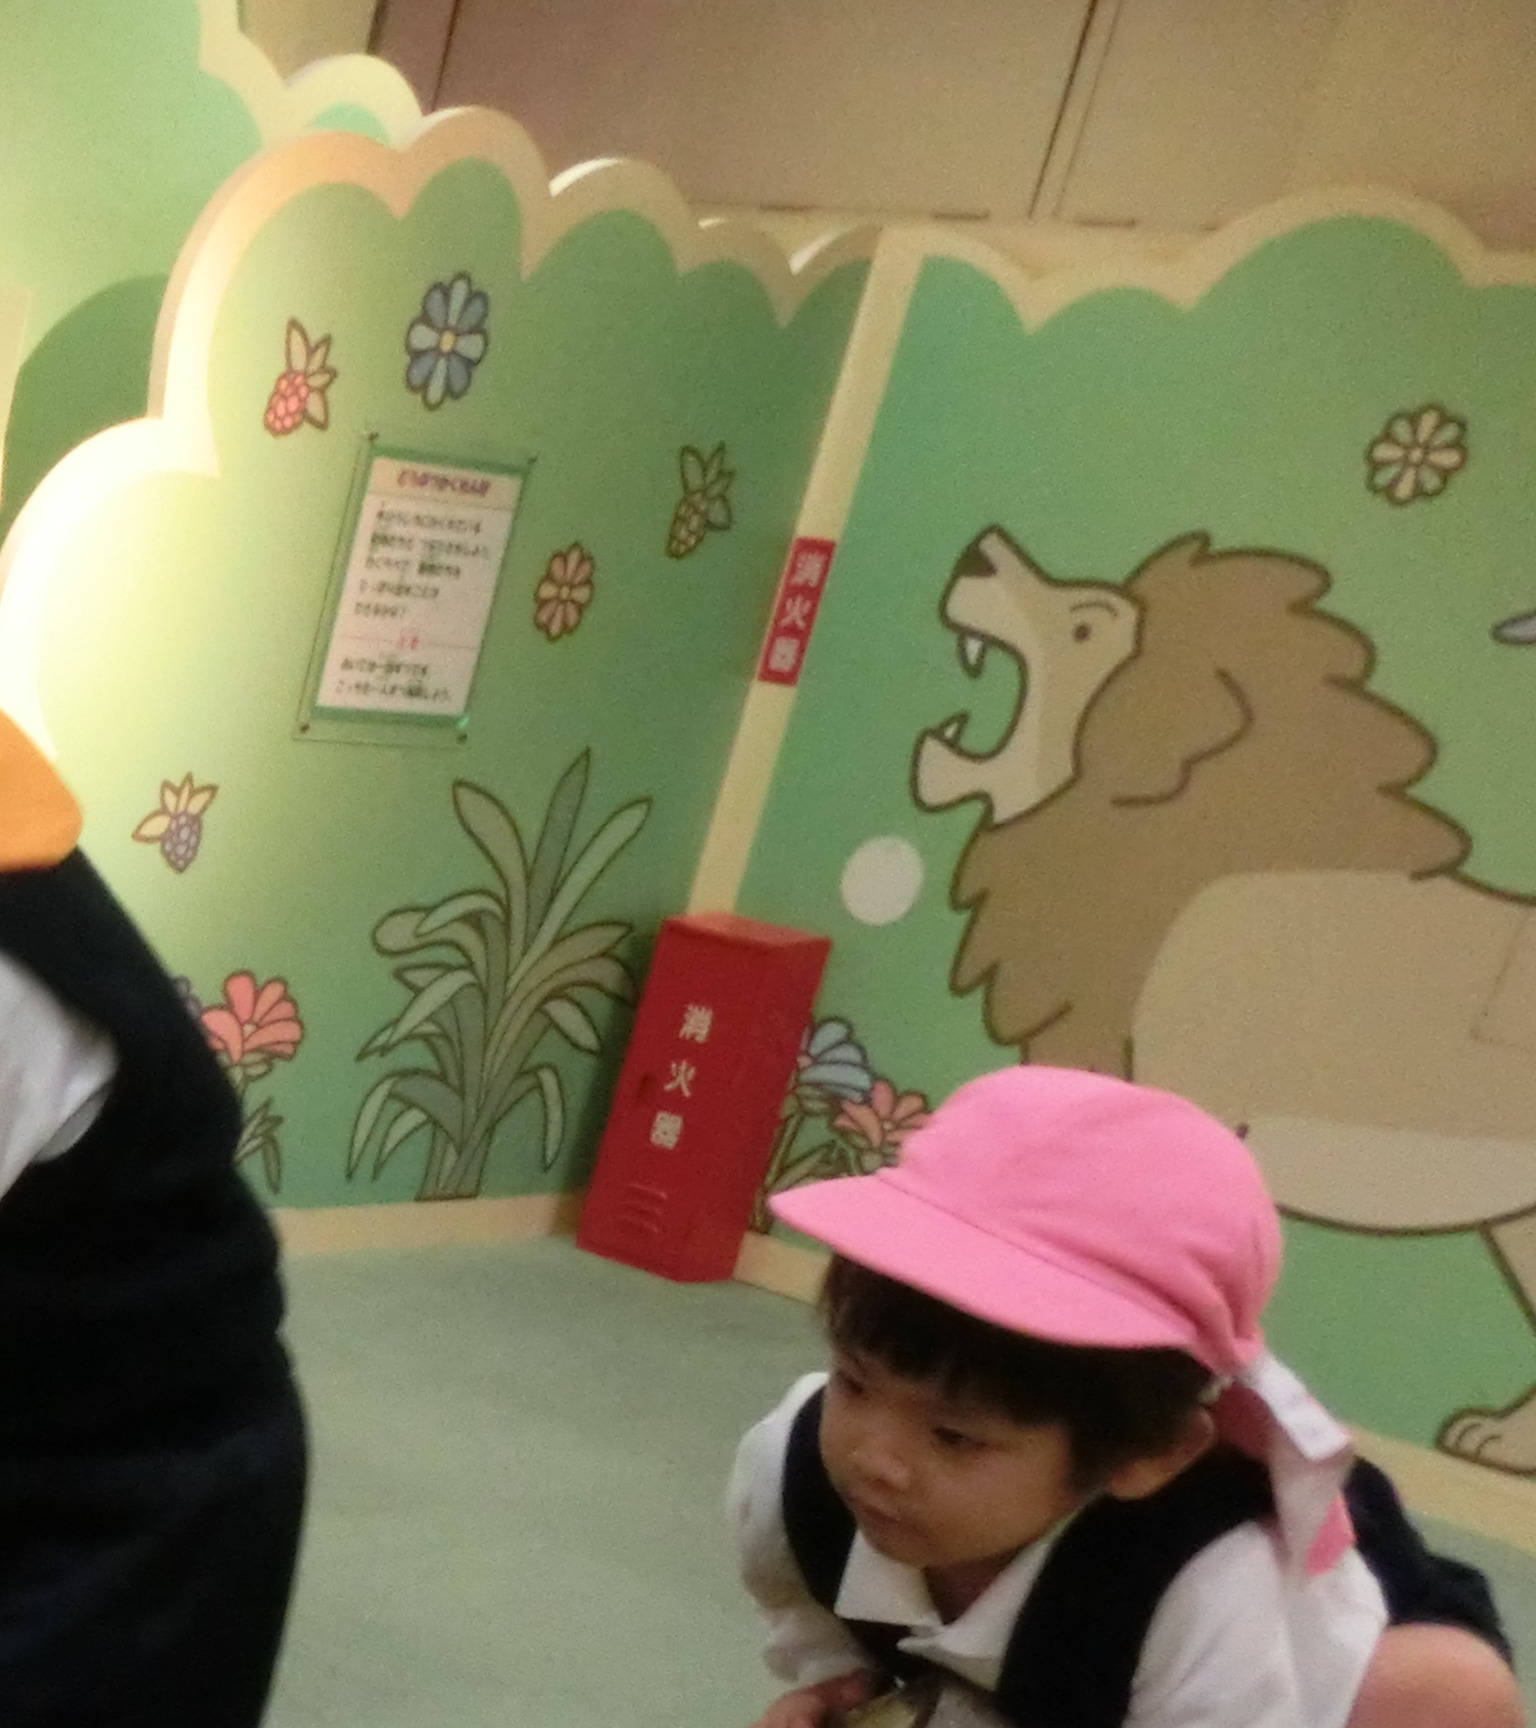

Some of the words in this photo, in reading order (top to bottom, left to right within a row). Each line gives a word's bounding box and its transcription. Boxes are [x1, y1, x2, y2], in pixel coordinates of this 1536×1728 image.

[768, 552, 828, 673] 消火器
[650, 1003, 713, 1150] 消火器
